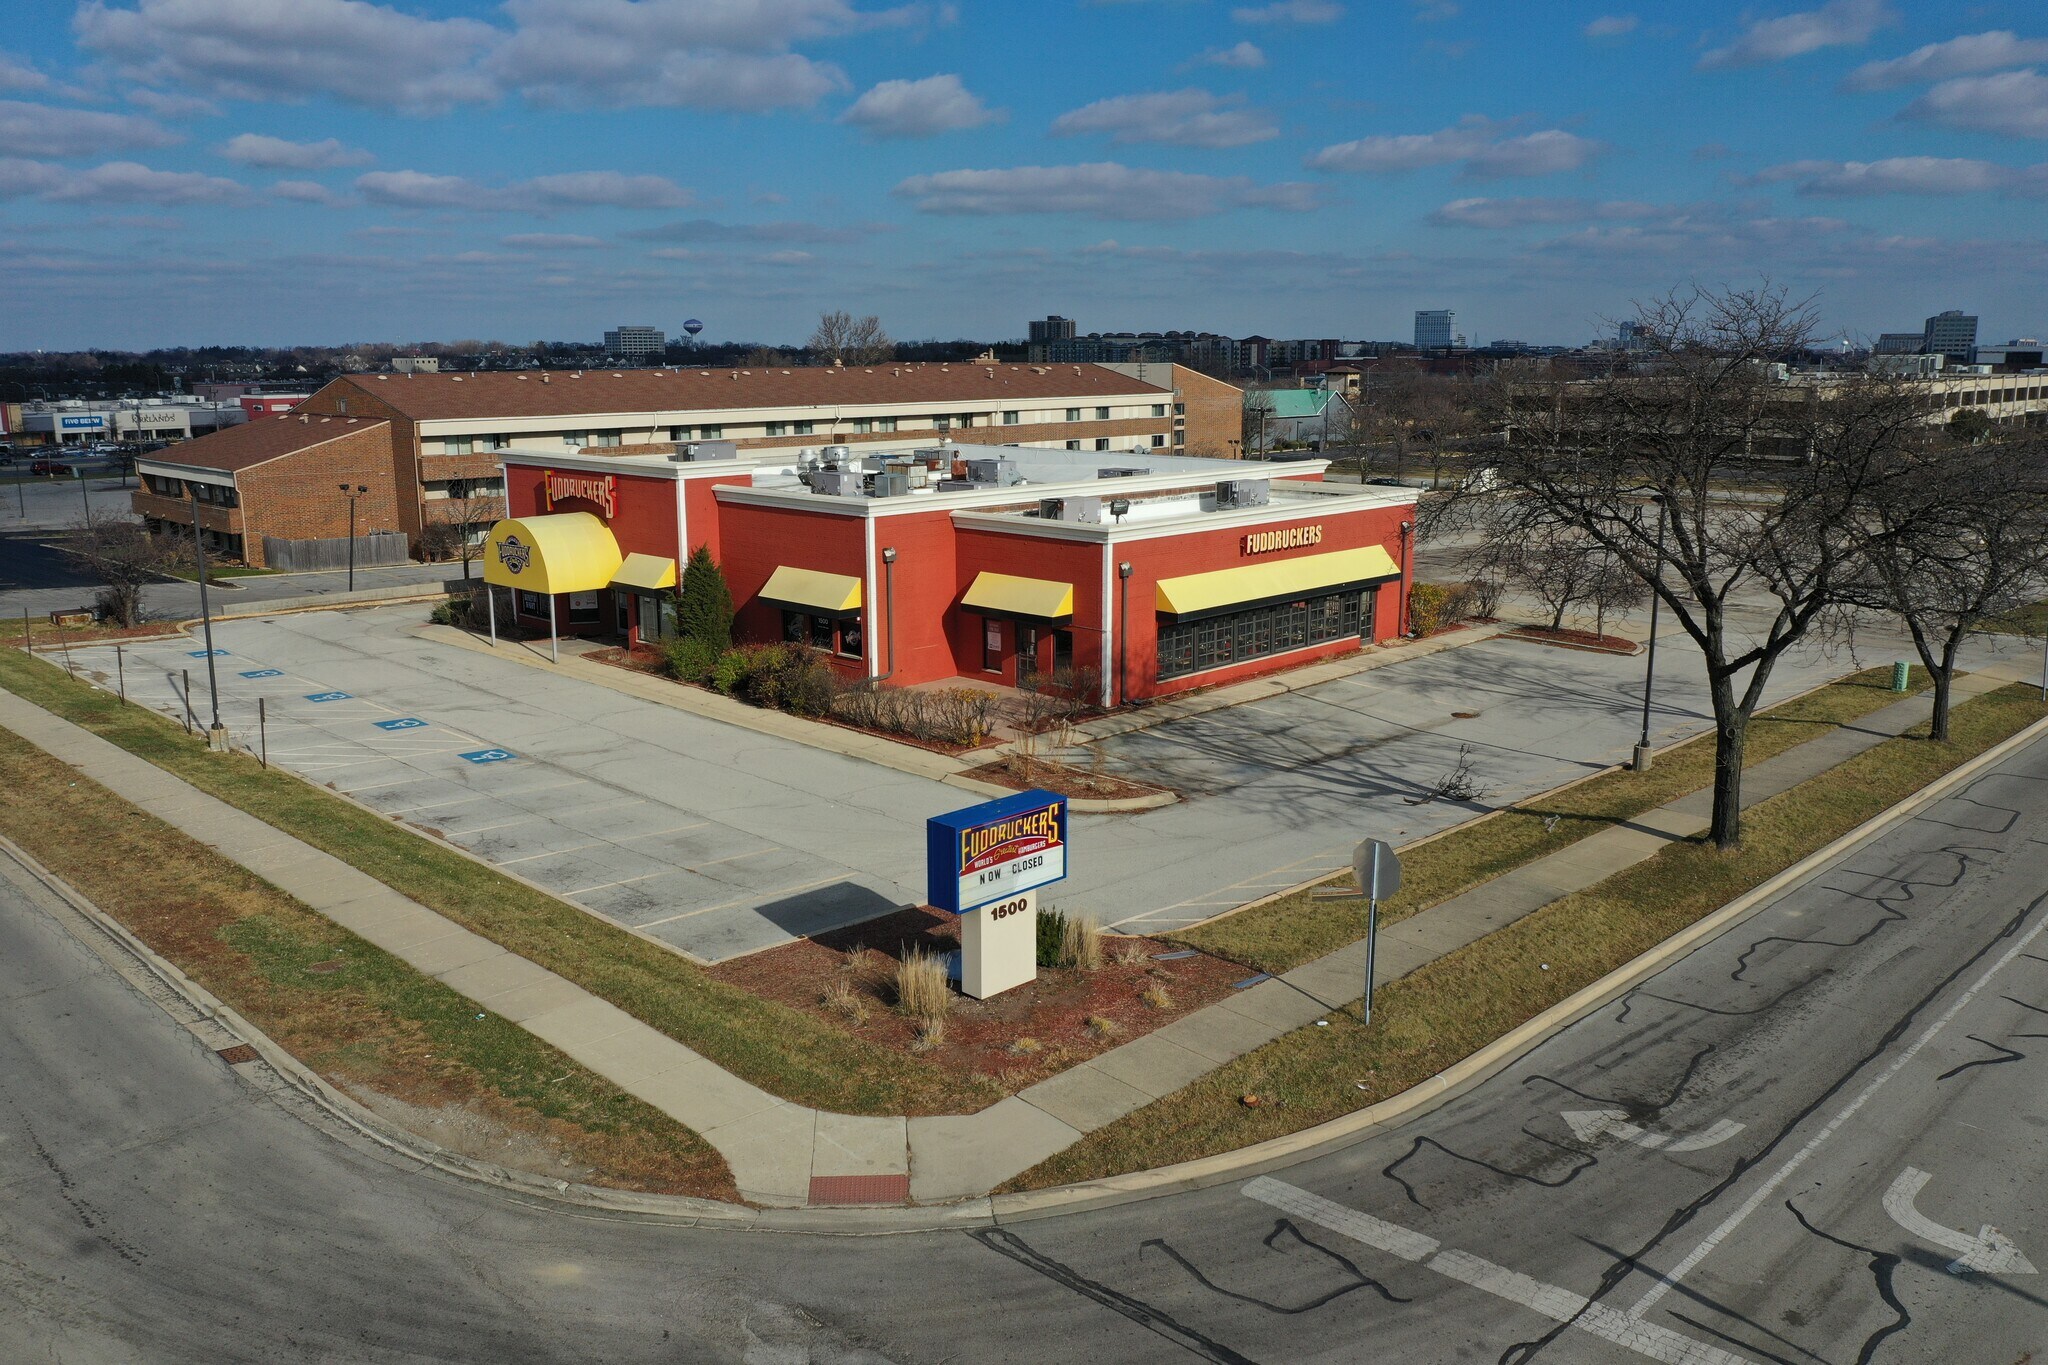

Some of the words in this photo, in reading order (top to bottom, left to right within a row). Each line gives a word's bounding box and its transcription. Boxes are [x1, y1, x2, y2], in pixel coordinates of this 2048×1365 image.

[132, 413, 175, 423] KRKLAND'S
[544, 470, 615, 518] FUDDRUCKERS
[1247, 524, 1322, 553] FUDDRUCKERS
[961, 803, 1058, 871] FUDDRUCKERS
[974, 856, 994, 869] WORLD'S
[1018, 840, 1046, 854] HAMBURGERS
[1012, 855, 1043, 874] CLOSED
[990, 898, 1028, 921] 1500
